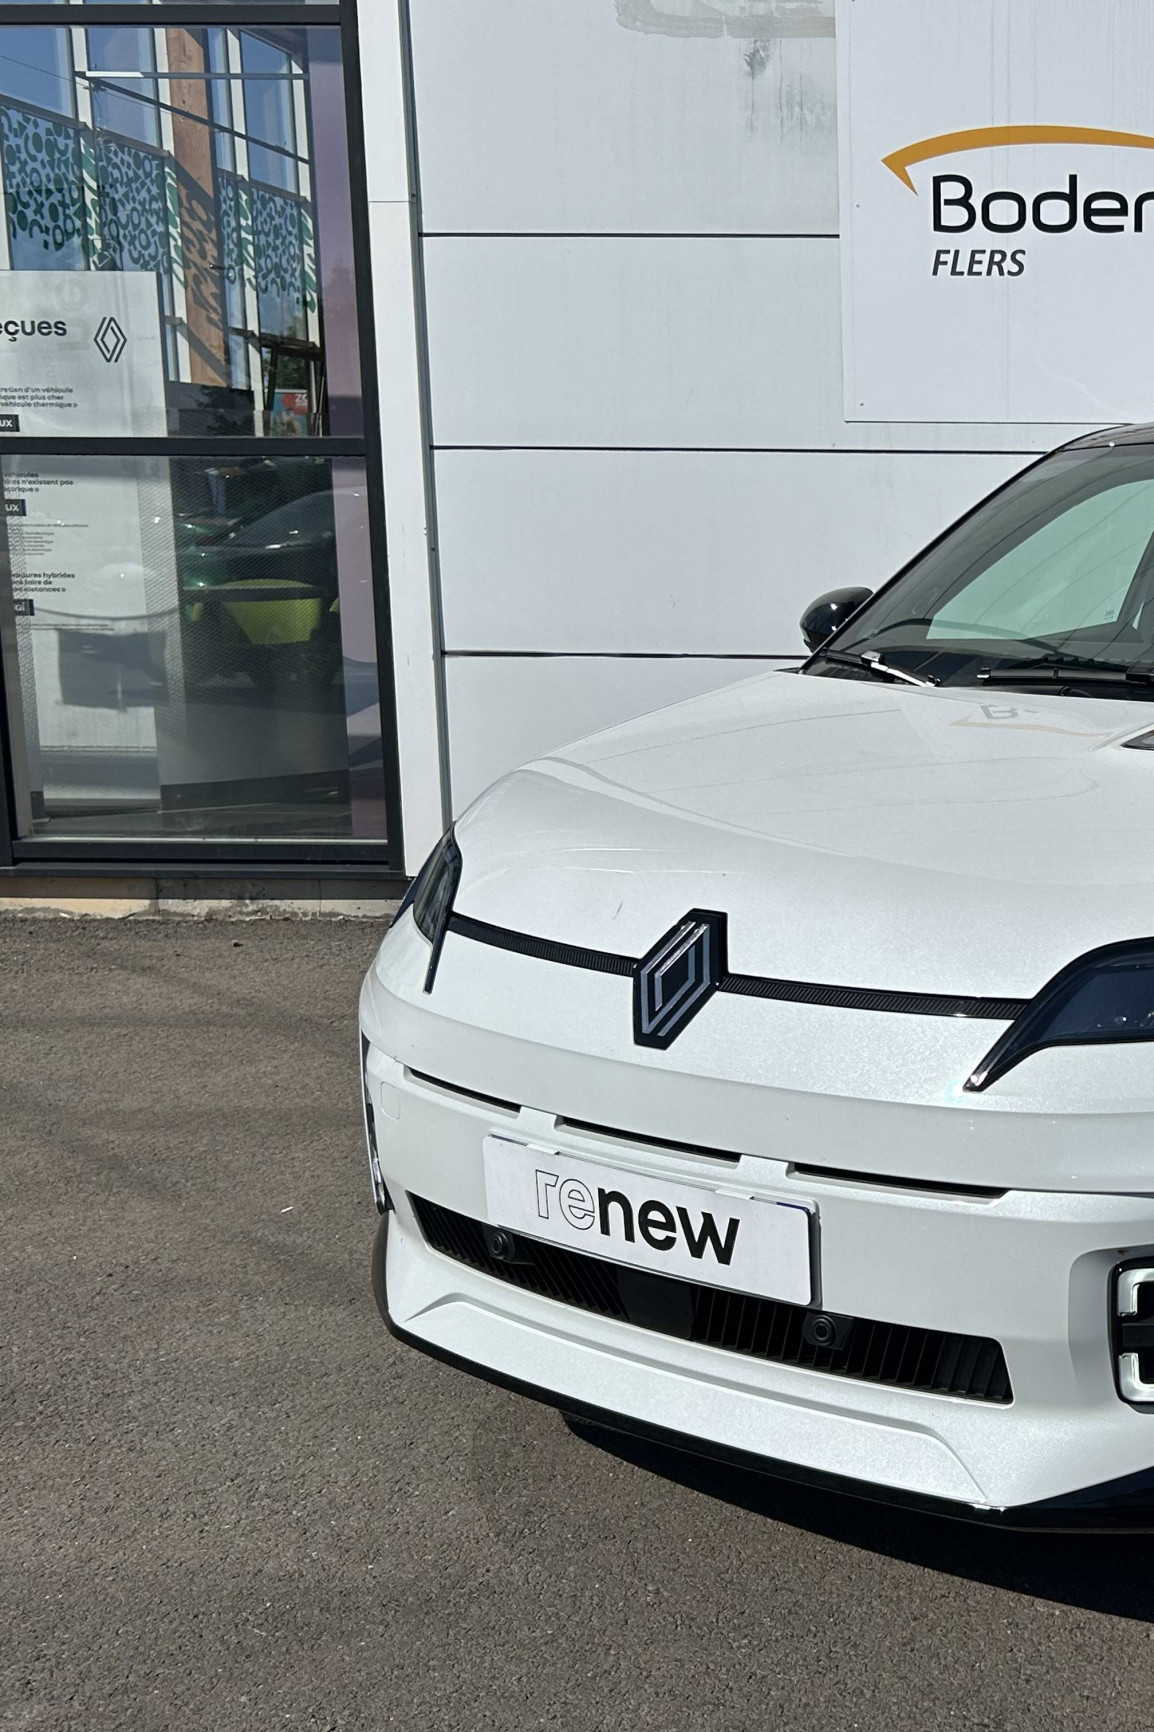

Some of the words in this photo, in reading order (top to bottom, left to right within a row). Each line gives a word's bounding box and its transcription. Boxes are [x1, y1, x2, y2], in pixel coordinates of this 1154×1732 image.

[932, 249, 1026, 277] FLERS
[0, 319, 67, 342] çues
[534, 1169, 740, 1267] renew
